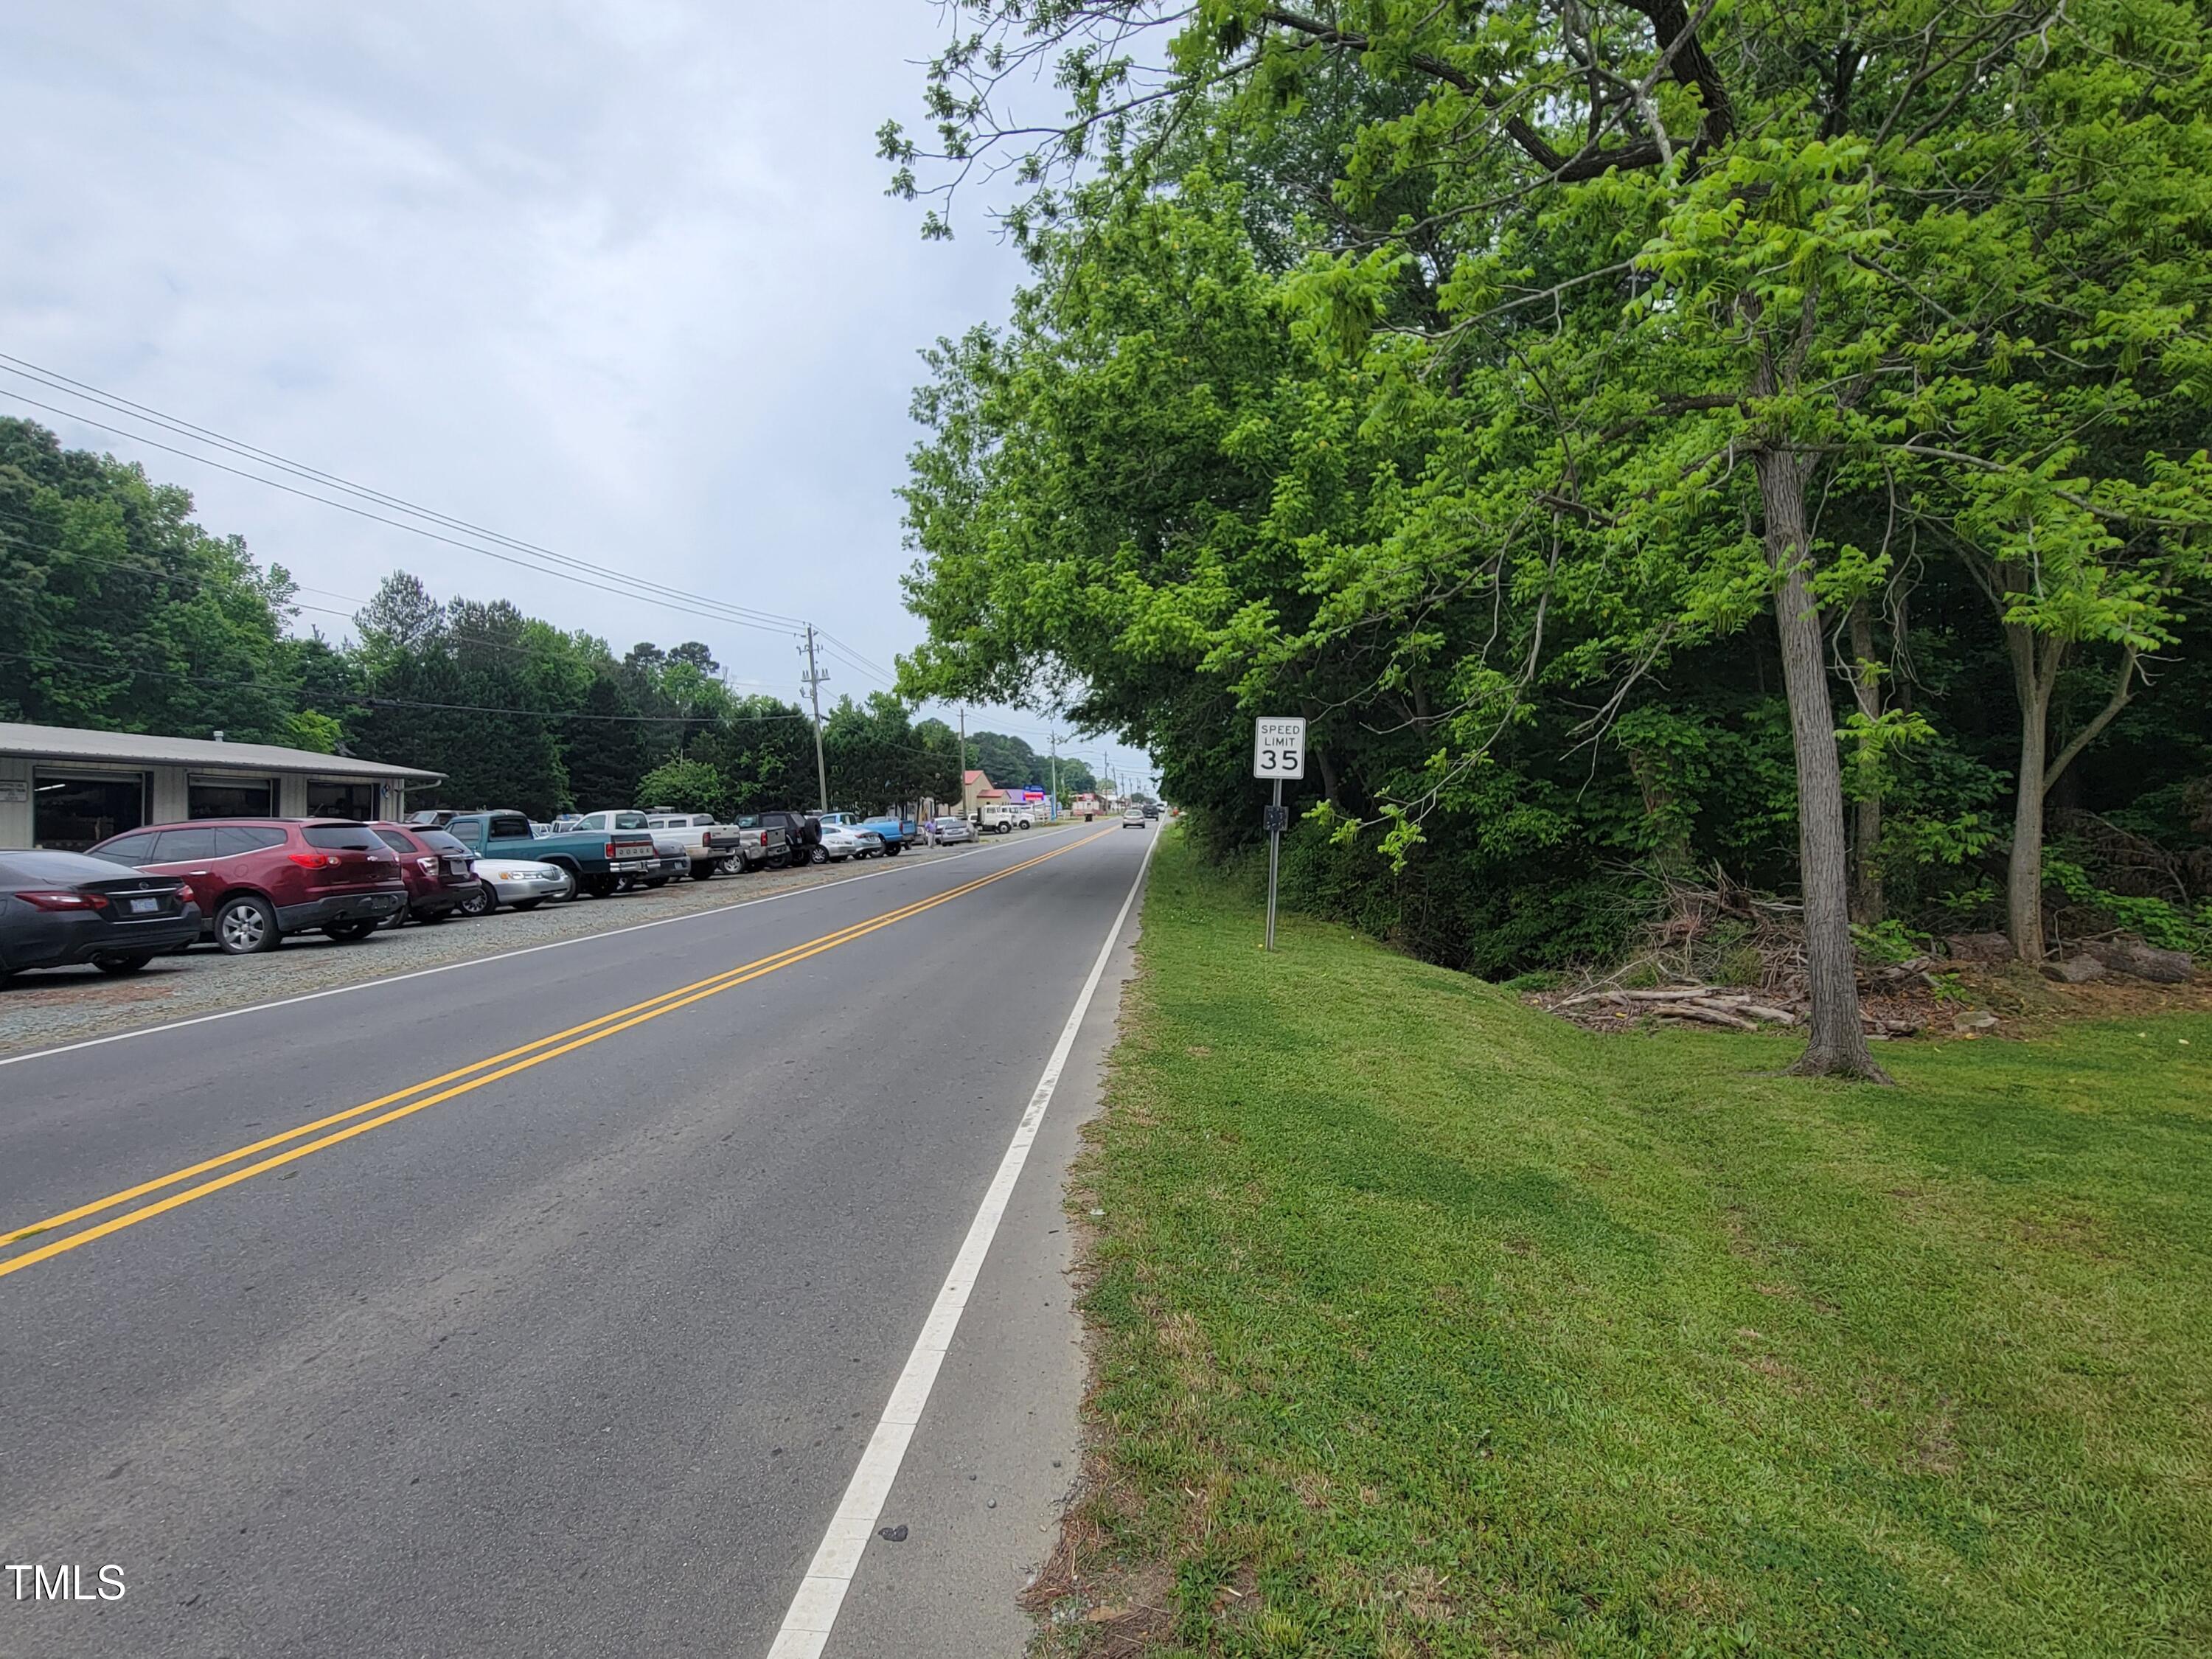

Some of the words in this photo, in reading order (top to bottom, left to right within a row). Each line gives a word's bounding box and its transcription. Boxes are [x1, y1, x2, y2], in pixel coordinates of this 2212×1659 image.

[1261, 725, 1300, 734] SPEED
[1265, 737, 1295, 746] LIMIT
[1261, 750, 1298, 771] 35
